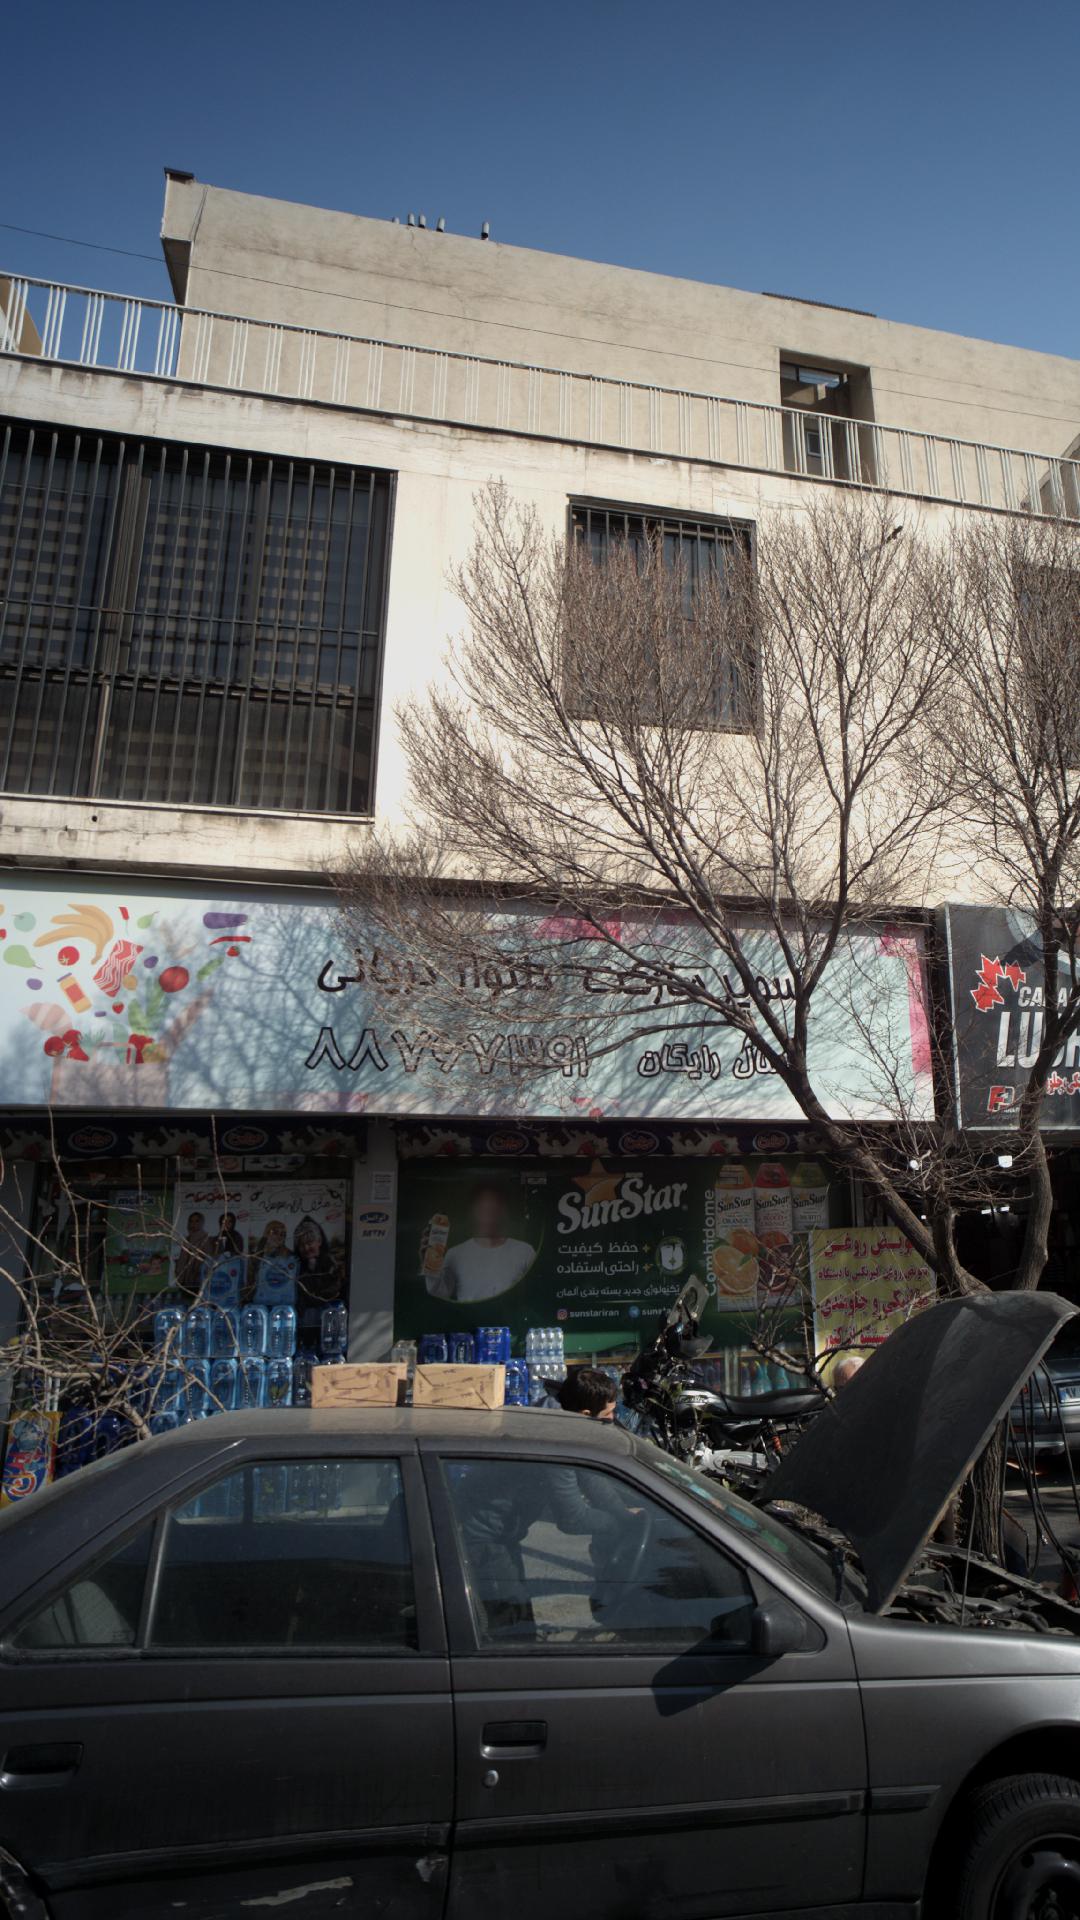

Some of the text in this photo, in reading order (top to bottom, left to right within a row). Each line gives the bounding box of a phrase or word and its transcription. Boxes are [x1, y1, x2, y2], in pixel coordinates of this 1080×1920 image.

[637, 1042, 721, 1081] رایگان
[556, 1176, 688, 1234] SunStar
[557, 1241, 640, 1258] حفظ کیفیت
[703, 1189, 718, 1297] Combidome
[556, 1259, 640, 1276] راحتی استفاده
